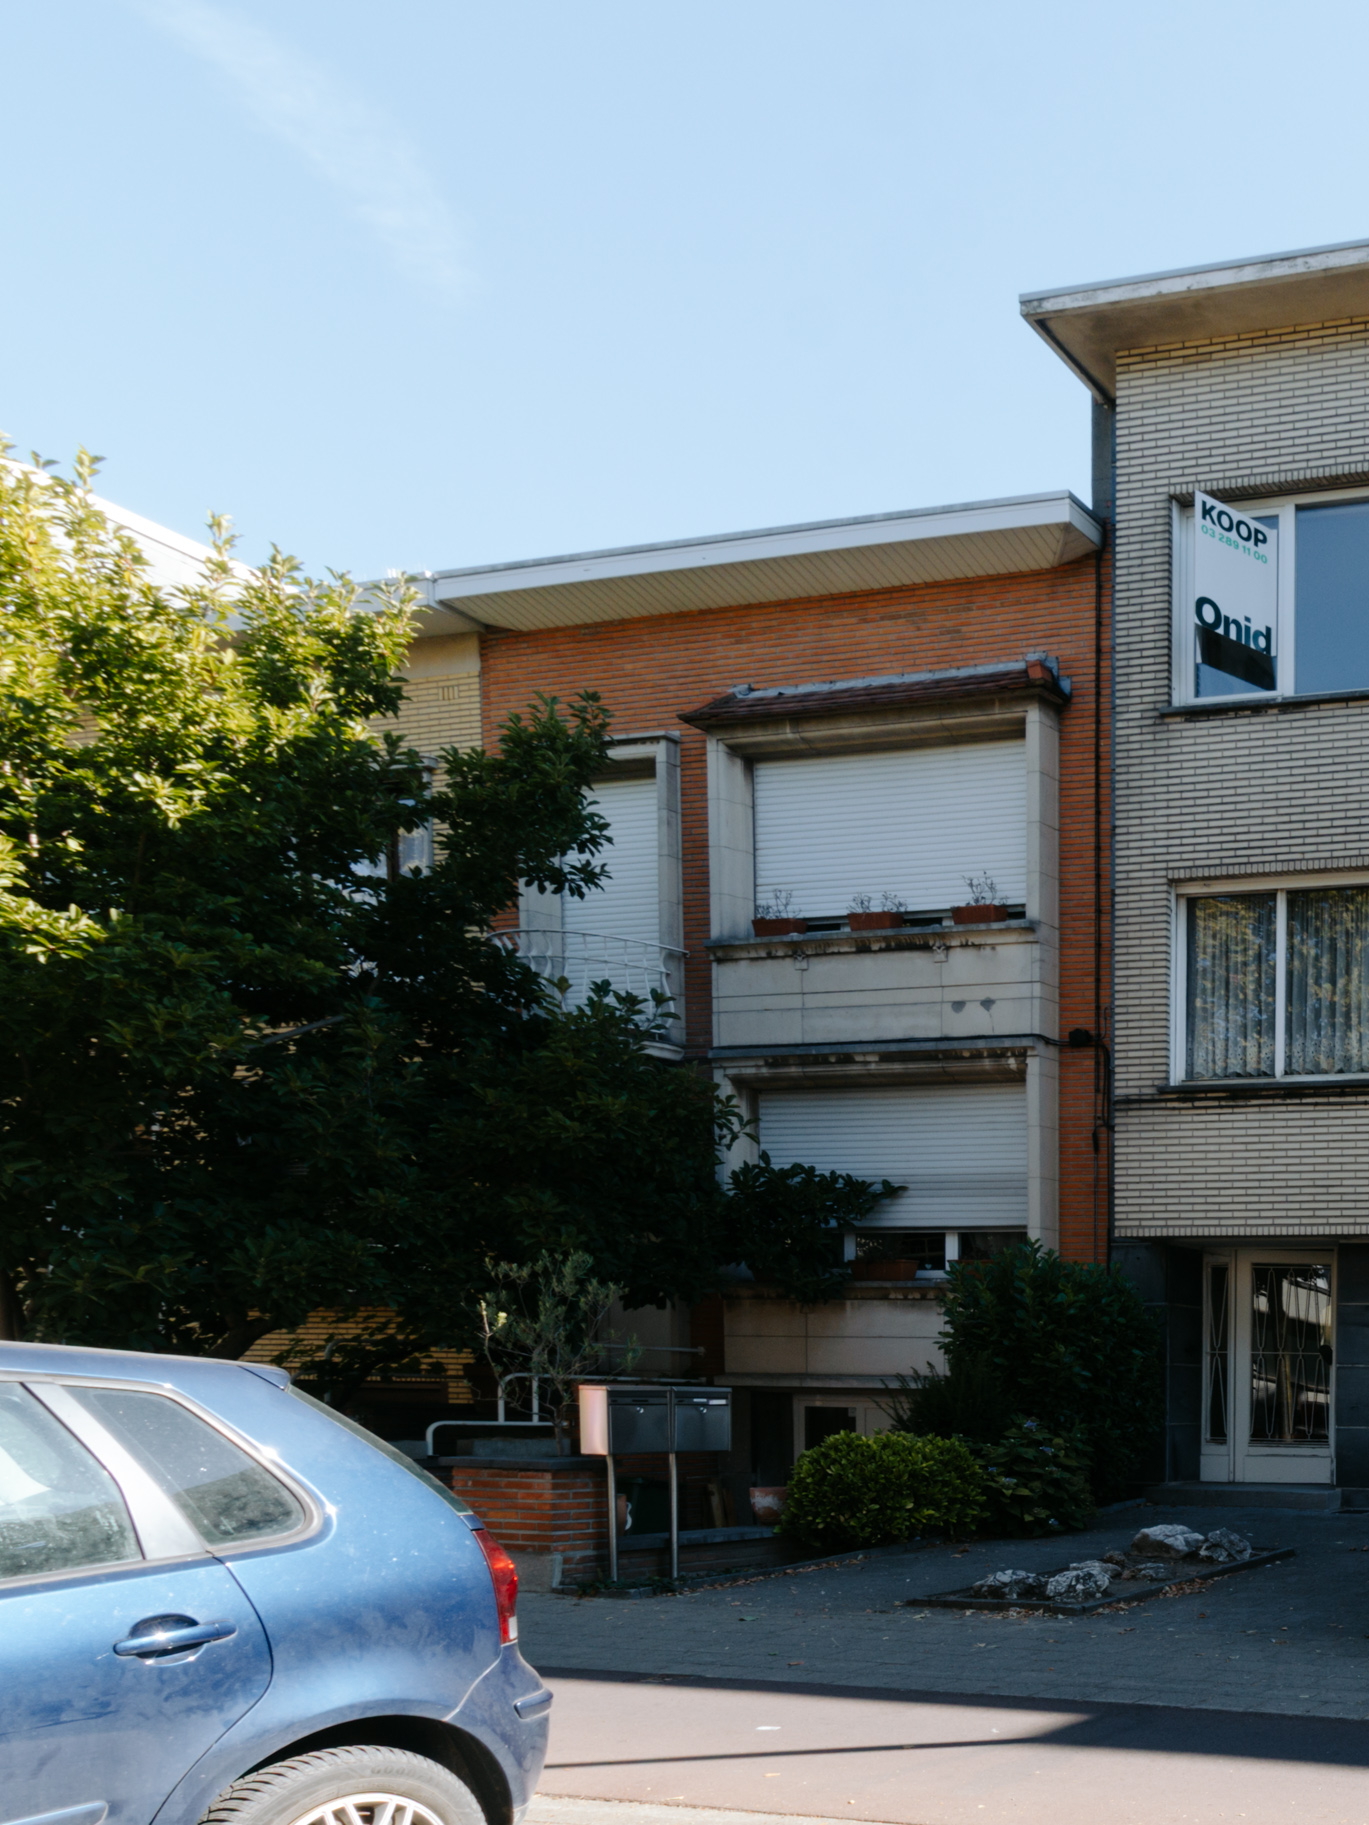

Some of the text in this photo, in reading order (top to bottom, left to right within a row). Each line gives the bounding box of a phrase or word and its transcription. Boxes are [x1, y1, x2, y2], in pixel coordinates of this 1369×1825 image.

[1201, 499, 1268, 548] KOOP
[1201, 524, 1268, 564] 03 289 11 00
